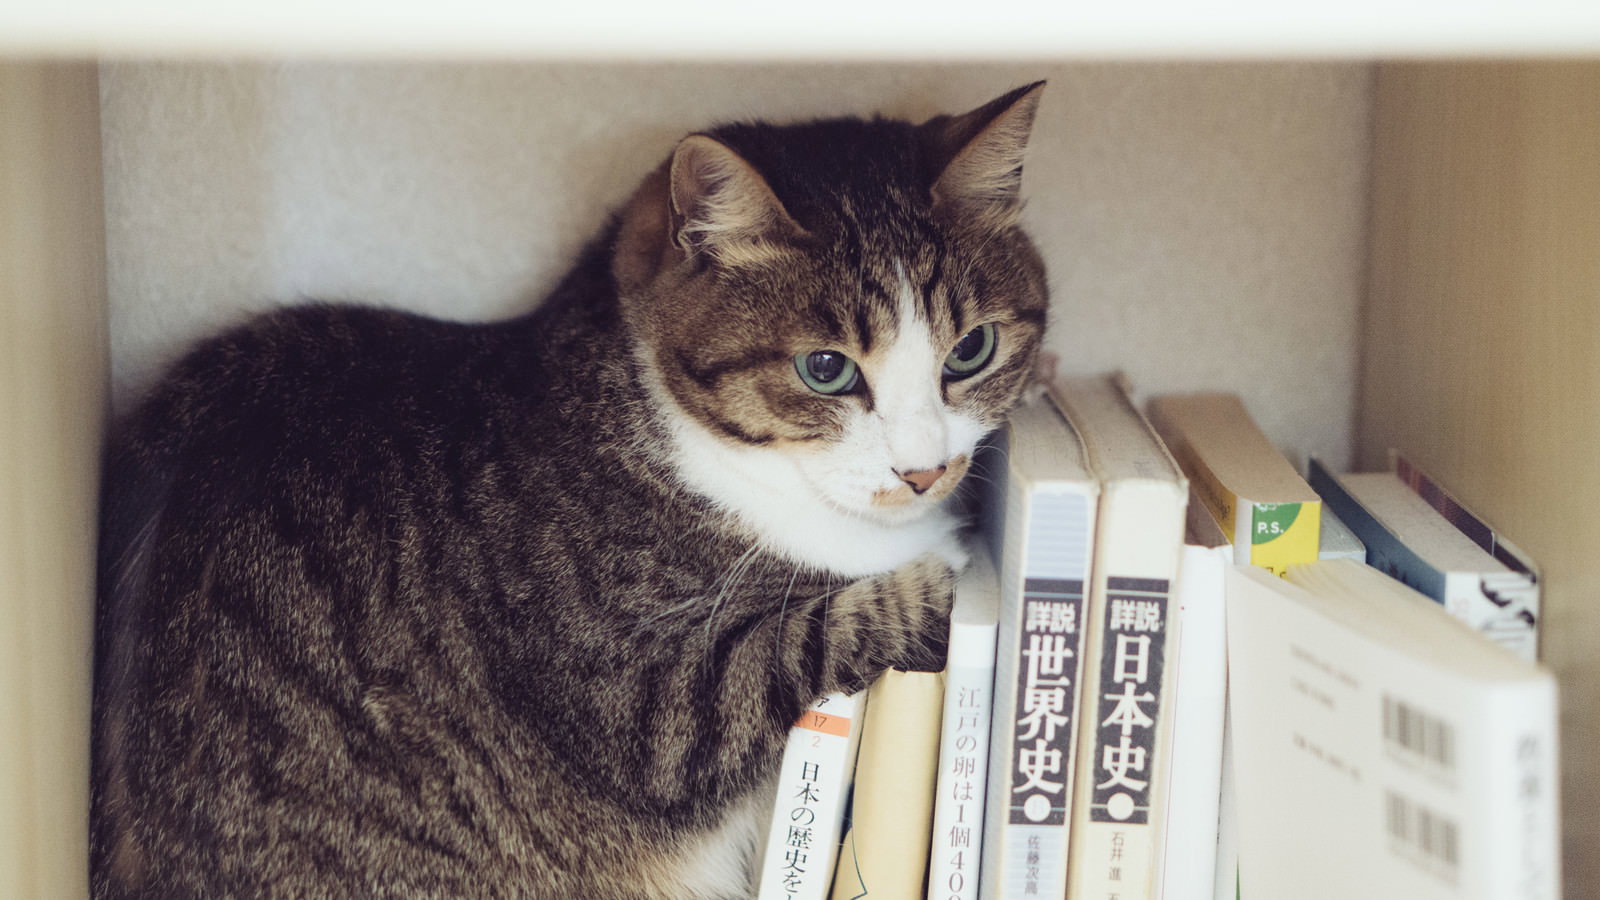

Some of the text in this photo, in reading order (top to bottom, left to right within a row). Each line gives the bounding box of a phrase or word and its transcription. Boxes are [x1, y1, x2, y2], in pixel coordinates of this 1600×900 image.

[1257, 521, 1284, 534] P.S.
[1026, 600, 1076, 633] 詳説
[1110, 599, 1160, 633] 詳説
[1013, 635, 1074, 794] 世界史
[1096, 634, 1155, 792] 日本史
[777, 761, 820, 900] 日本の歴史を
[948, 686, 982, 900] 江戸の卵は1個40
